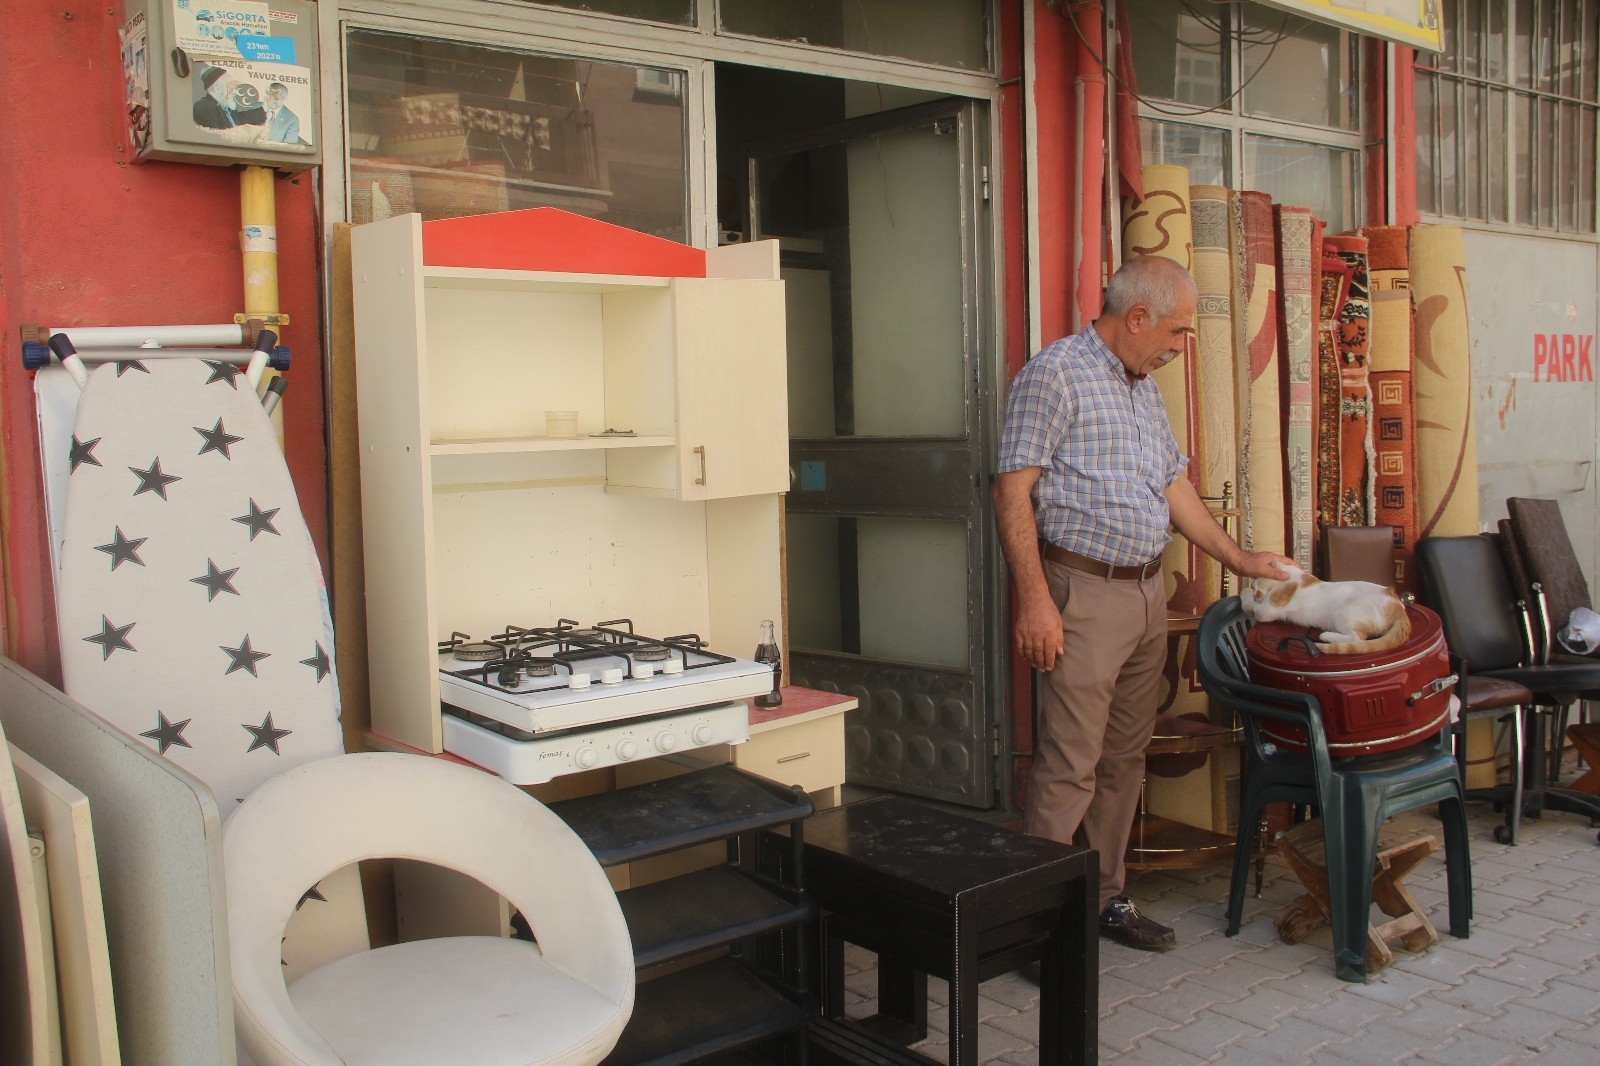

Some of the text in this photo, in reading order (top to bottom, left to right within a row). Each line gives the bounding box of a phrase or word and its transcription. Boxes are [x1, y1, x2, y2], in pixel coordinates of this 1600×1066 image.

[242, 22, 268, 30] Hizmetleri
[247, 71, 309, 85] YAVUZ GEREK
[1533, 333, 1594, 383] PARK
[537, 750, 563, 761] femas
